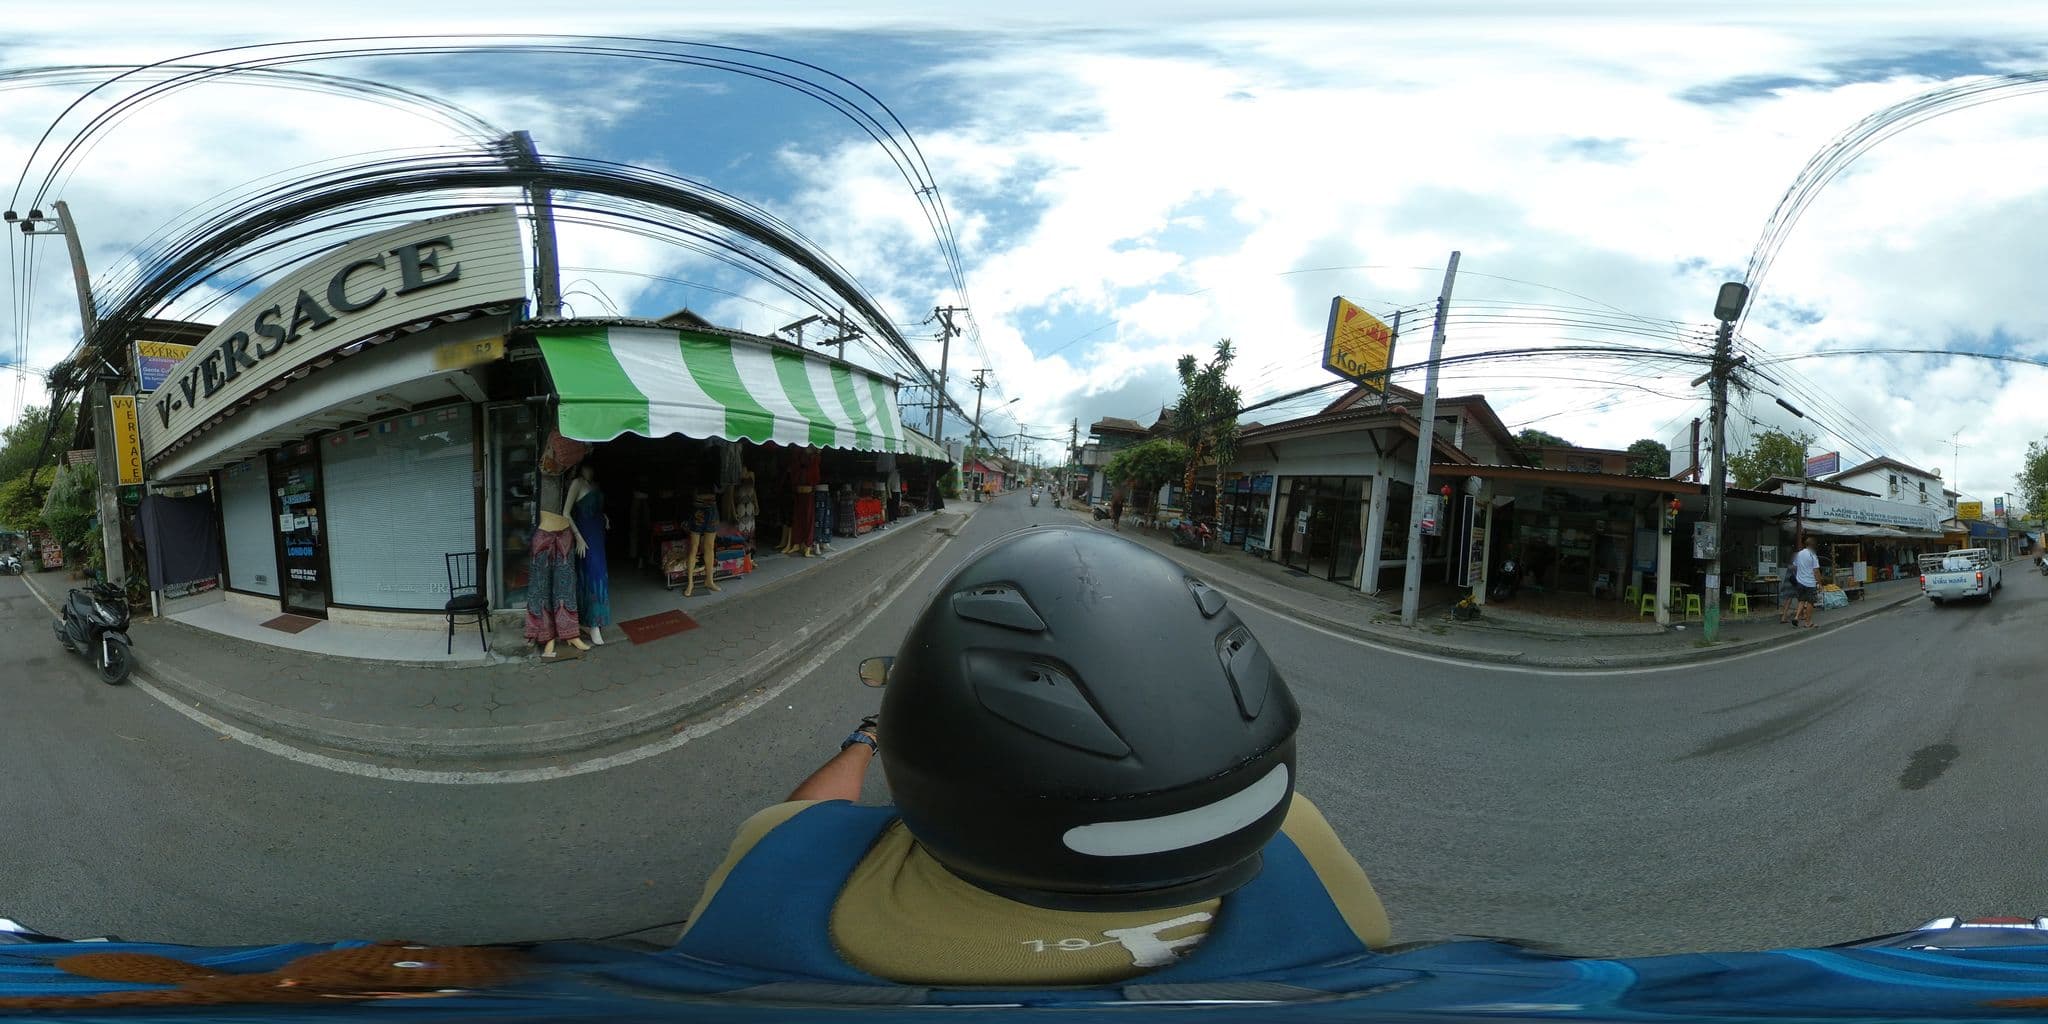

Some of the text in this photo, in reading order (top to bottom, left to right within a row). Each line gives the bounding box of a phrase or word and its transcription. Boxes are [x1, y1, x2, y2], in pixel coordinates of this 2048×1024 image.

[155, 235, 461, 429] V-VERSACE
[1823, 511, 1852, 519] DAMEN
[1831, 507, 1859, 515] LADIES
